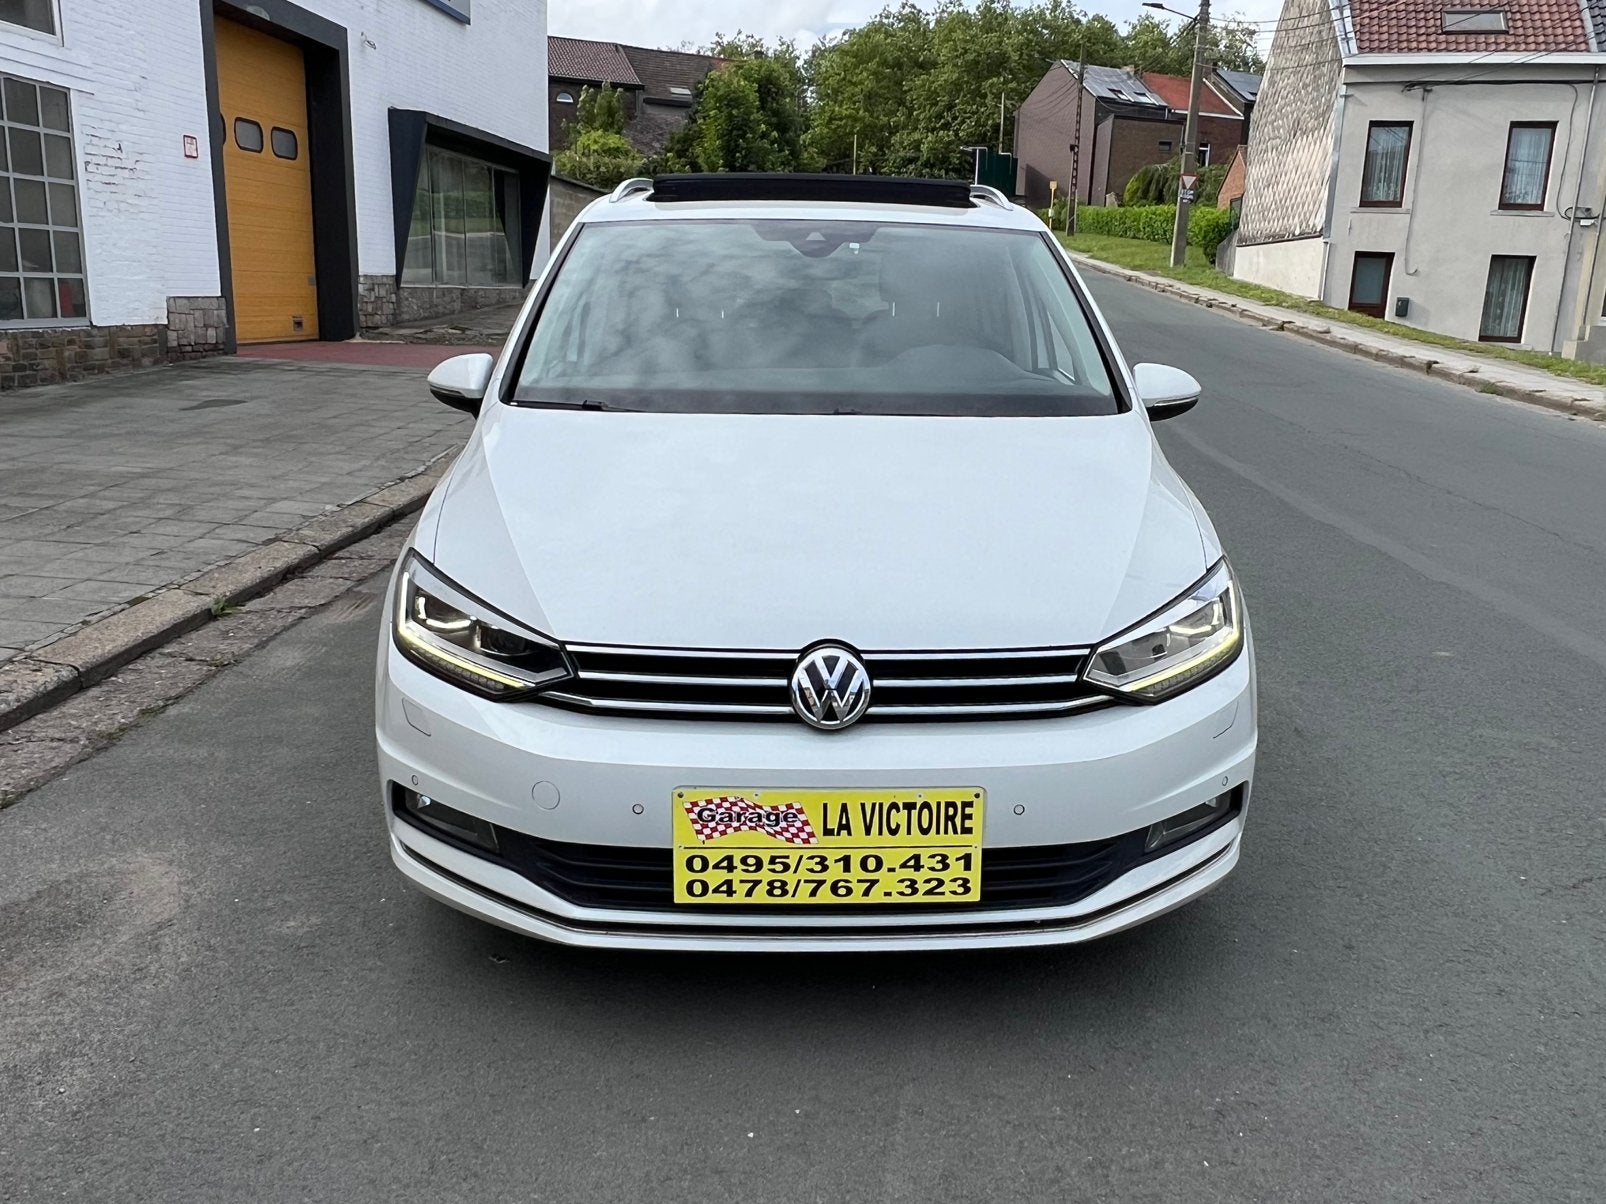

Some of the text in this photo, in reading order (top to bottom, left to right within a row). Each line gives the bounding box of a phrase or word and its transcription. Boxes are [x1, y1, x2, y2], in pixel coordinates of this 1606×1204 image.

[793, 648, 870, 727] VW
[696, 800, 974, 836] Garage LA VICTOIRE
[685, 853, 972, 874] 0495/310.431
[685, 877, 972, 898] 0478/767.323
